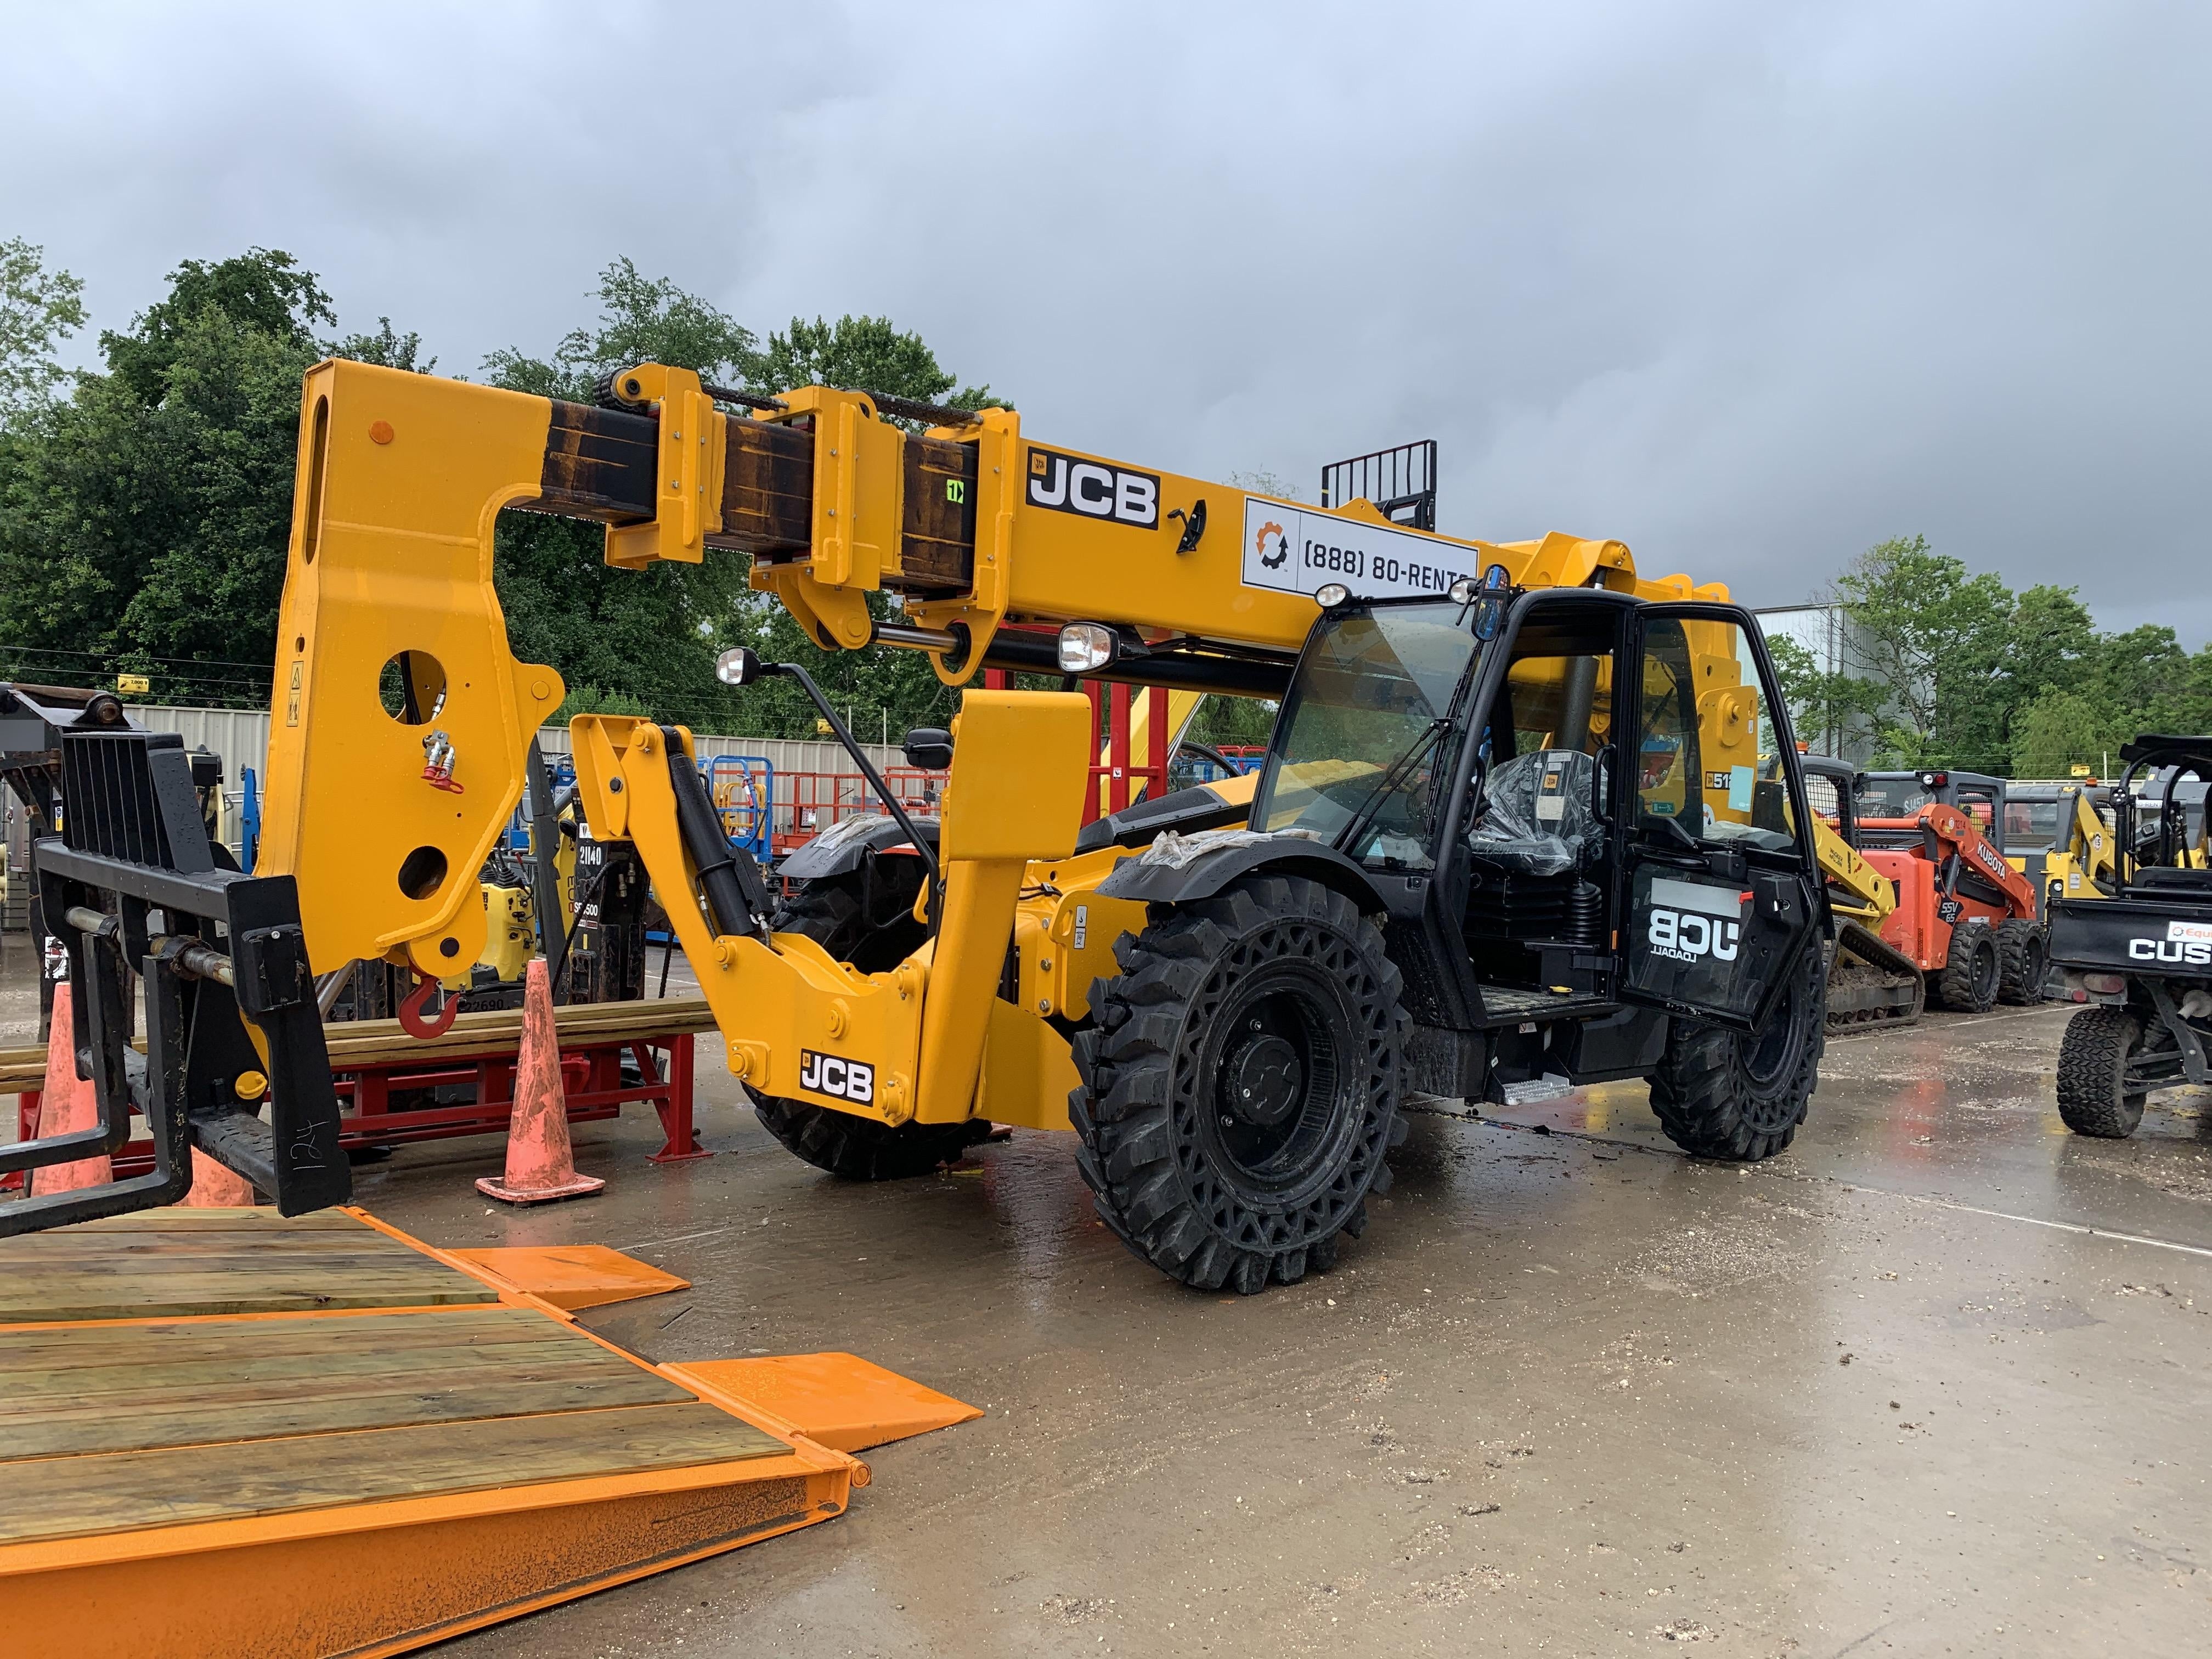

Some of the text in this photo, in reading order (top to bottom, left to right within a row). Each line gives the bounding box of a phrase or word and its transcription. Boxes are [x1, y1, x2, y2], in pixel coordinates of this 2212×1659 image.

[1031, 459, 1156, 523] JCB
[1305, 540, 1468, 591] (888) 80-RENT
[1714, 774, 1731, 788] 51
[580, 846, 601, 865] 21140
[1978, 842, 2006, 881] KUBOTA
[1942, 902, 1959, 913] SSV
[1946, 913, 1955, 922] 65
[2129, 938, 2211, 964] CUS
[802, 1055, 872, 1102] JCB
